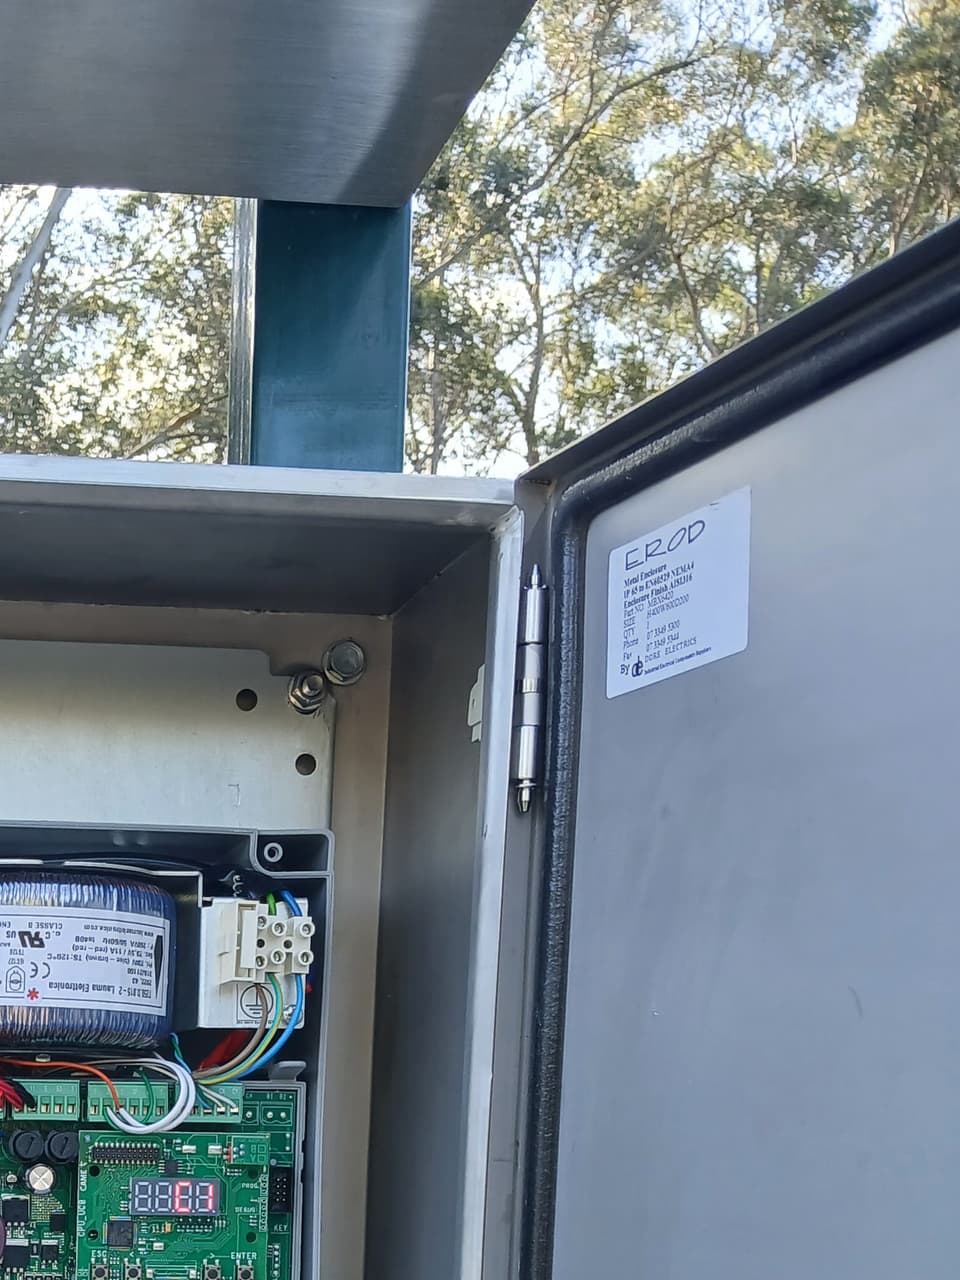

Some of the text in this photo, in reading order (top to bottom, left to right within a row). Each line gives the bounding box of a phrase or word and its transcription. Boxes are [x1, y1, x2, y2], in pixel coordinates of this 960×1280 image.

[625, 519, 706, 571] EROD
[640, 564, 667, 581] Enclosure
[624, 593, 649, 609] Enclosure
[48, 981, 90, 993] Elettronica
[92, 984, 115, 995] Lauma
[79, 1169, 88, 1192] CAME
[273, 1224, 288, 1232] KEY
[91, 1250, 108, 1258] ESC
[231, 1251, 257, 1260] ENTER
